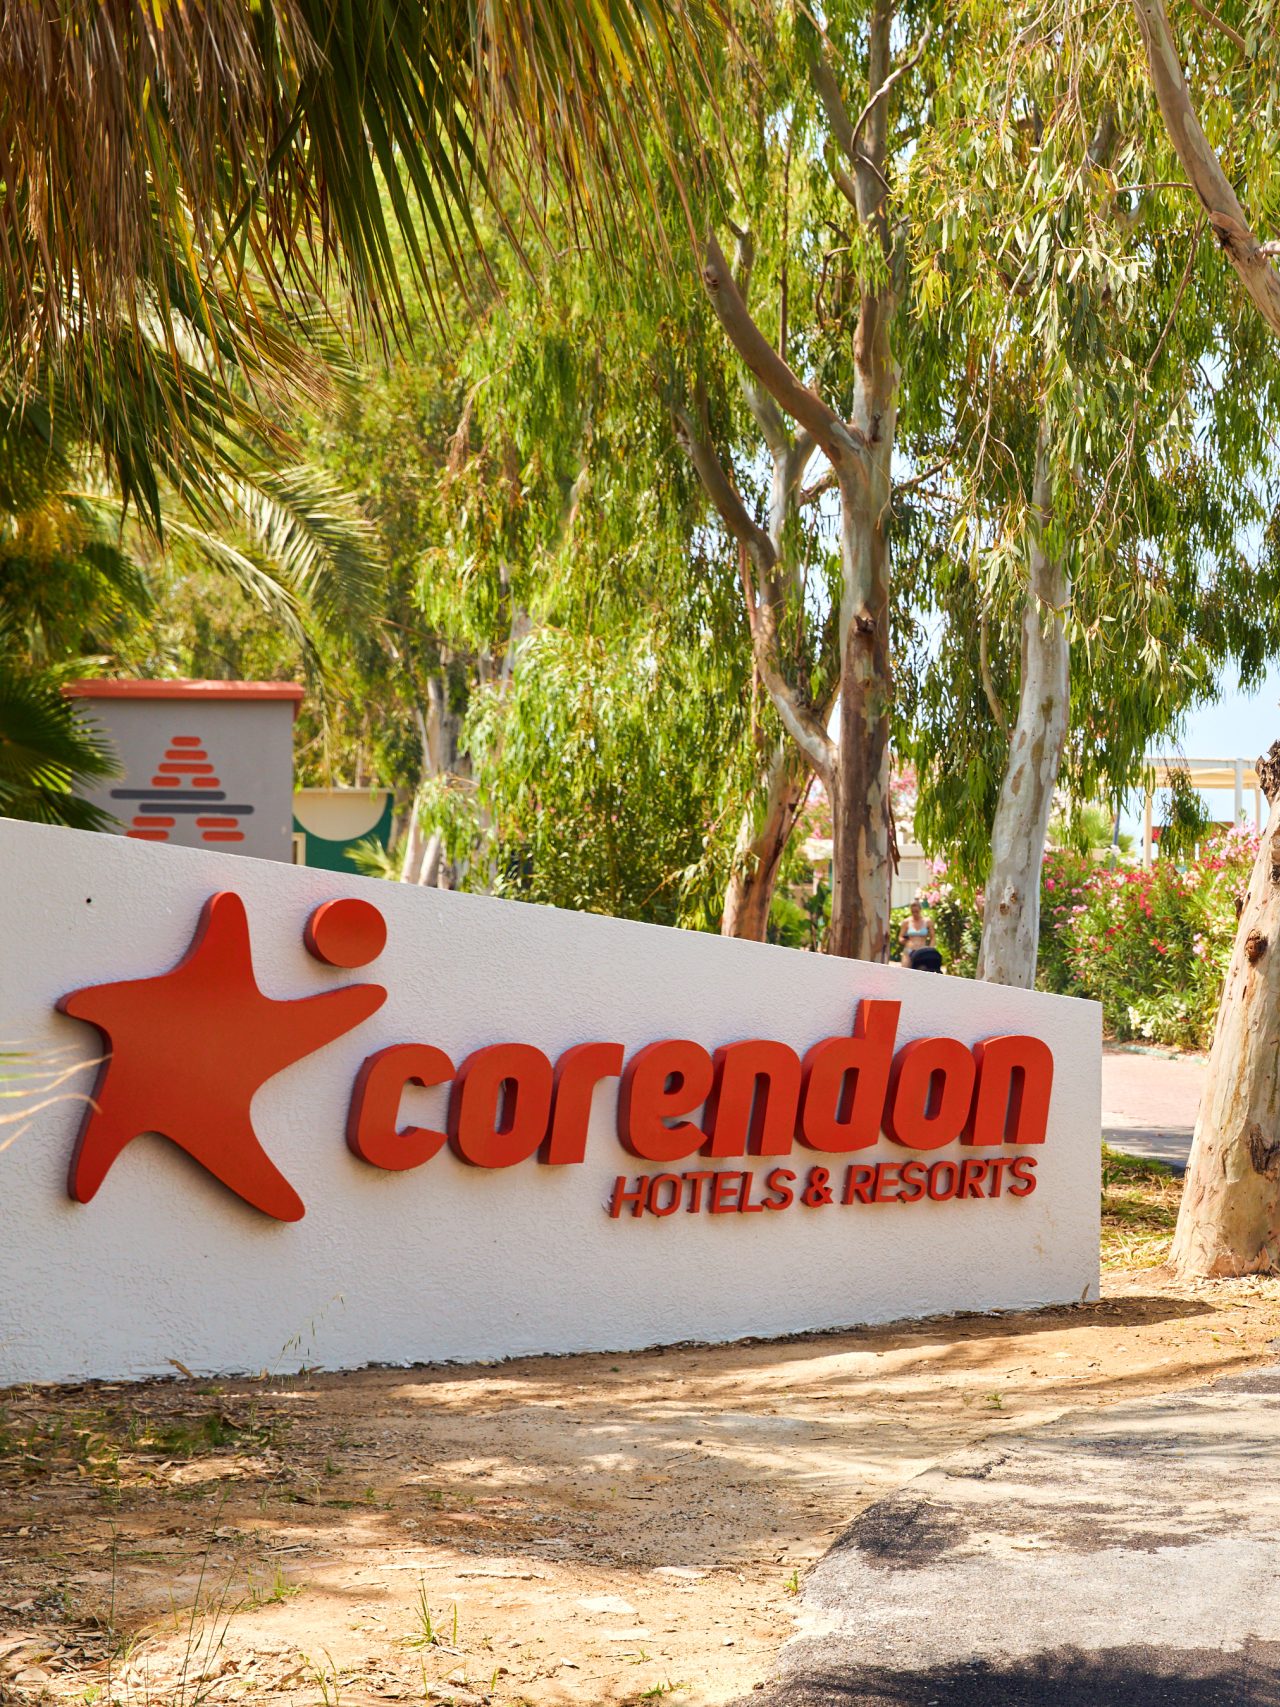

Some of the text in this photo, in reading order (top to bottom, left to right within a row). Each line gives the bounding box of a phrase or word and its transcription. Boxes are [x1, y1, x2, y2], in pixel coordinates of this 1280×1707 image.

[347, 1000, 1053, 1171] corendon
[609, 1156, 1038, 1218] HOTELS & RESORTS
